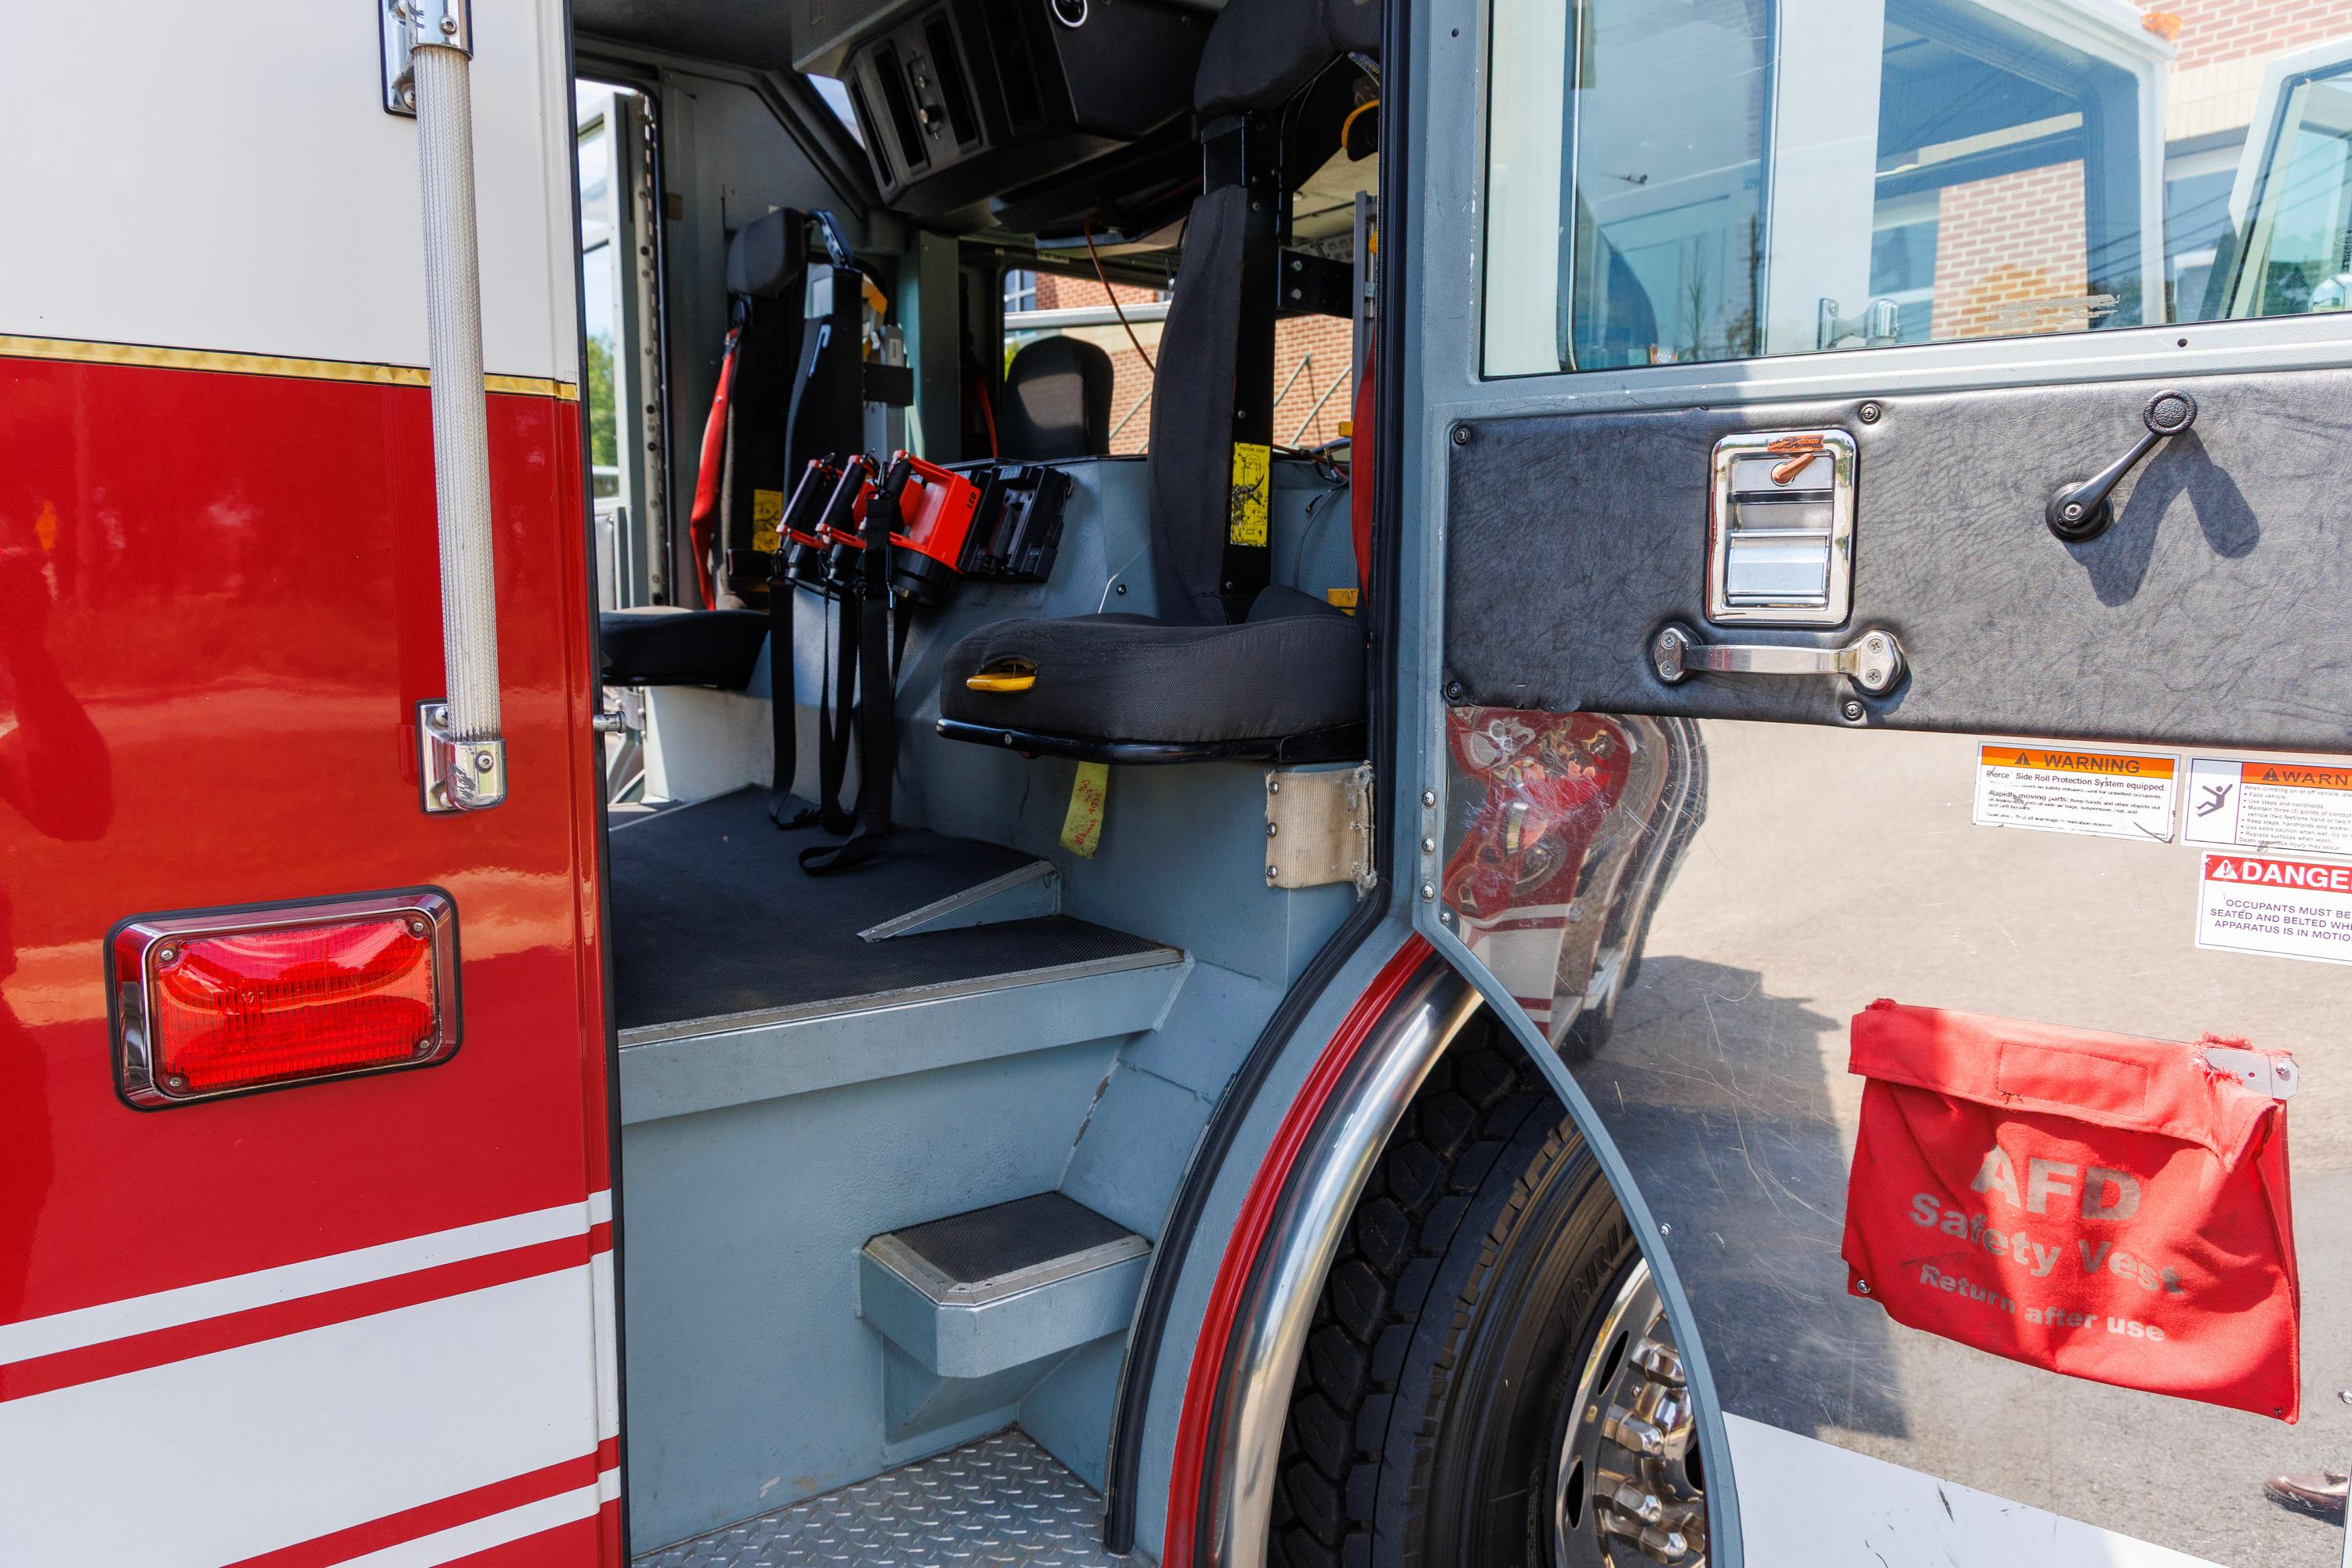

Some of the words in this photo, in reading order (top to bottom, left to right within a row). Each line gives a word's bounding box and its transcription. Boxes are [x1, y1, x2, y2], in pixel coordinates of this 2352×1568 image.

[967, 492, 977, 510] LED
[2044, 753, 2140, 774] WARNING
[1986, 770, 2010, 779] Pierce
[2016, 772, 2033, 781] Side
[2052, 775, 2092, 786] Protection
[2094, 779, 2124, 788] System
[2282, 771, 2349, 786] WARN
[2019, 793, 2046, 801] moving
[2241, 861, 2352, 891] DANGE
[2210, 908, 2253, 920] SEATED
[2256, 913, 2280, 923] AND
[2283, 916, 2327, 927] BELTED
[2226, 899, 2296, 913] OCCUPANTS
[2299, 906, 2332, 916] MUST
[2336, 910, 2351, 919] BE
[2214, 920, 2280, 934] APPARATUS
[2312, 931, 2352, 942] MOTIO
[1970, 1144, 2143, 1221] AFD
[1909, 1192, 2062, 1278] Safety
[2078, 1240, 2184, 1294] Vest
[1919, 1264, 2016, 1316] Return
[2024, 1306, 2099, 1327] after
[2107, 1316, 2165, 1341] use
